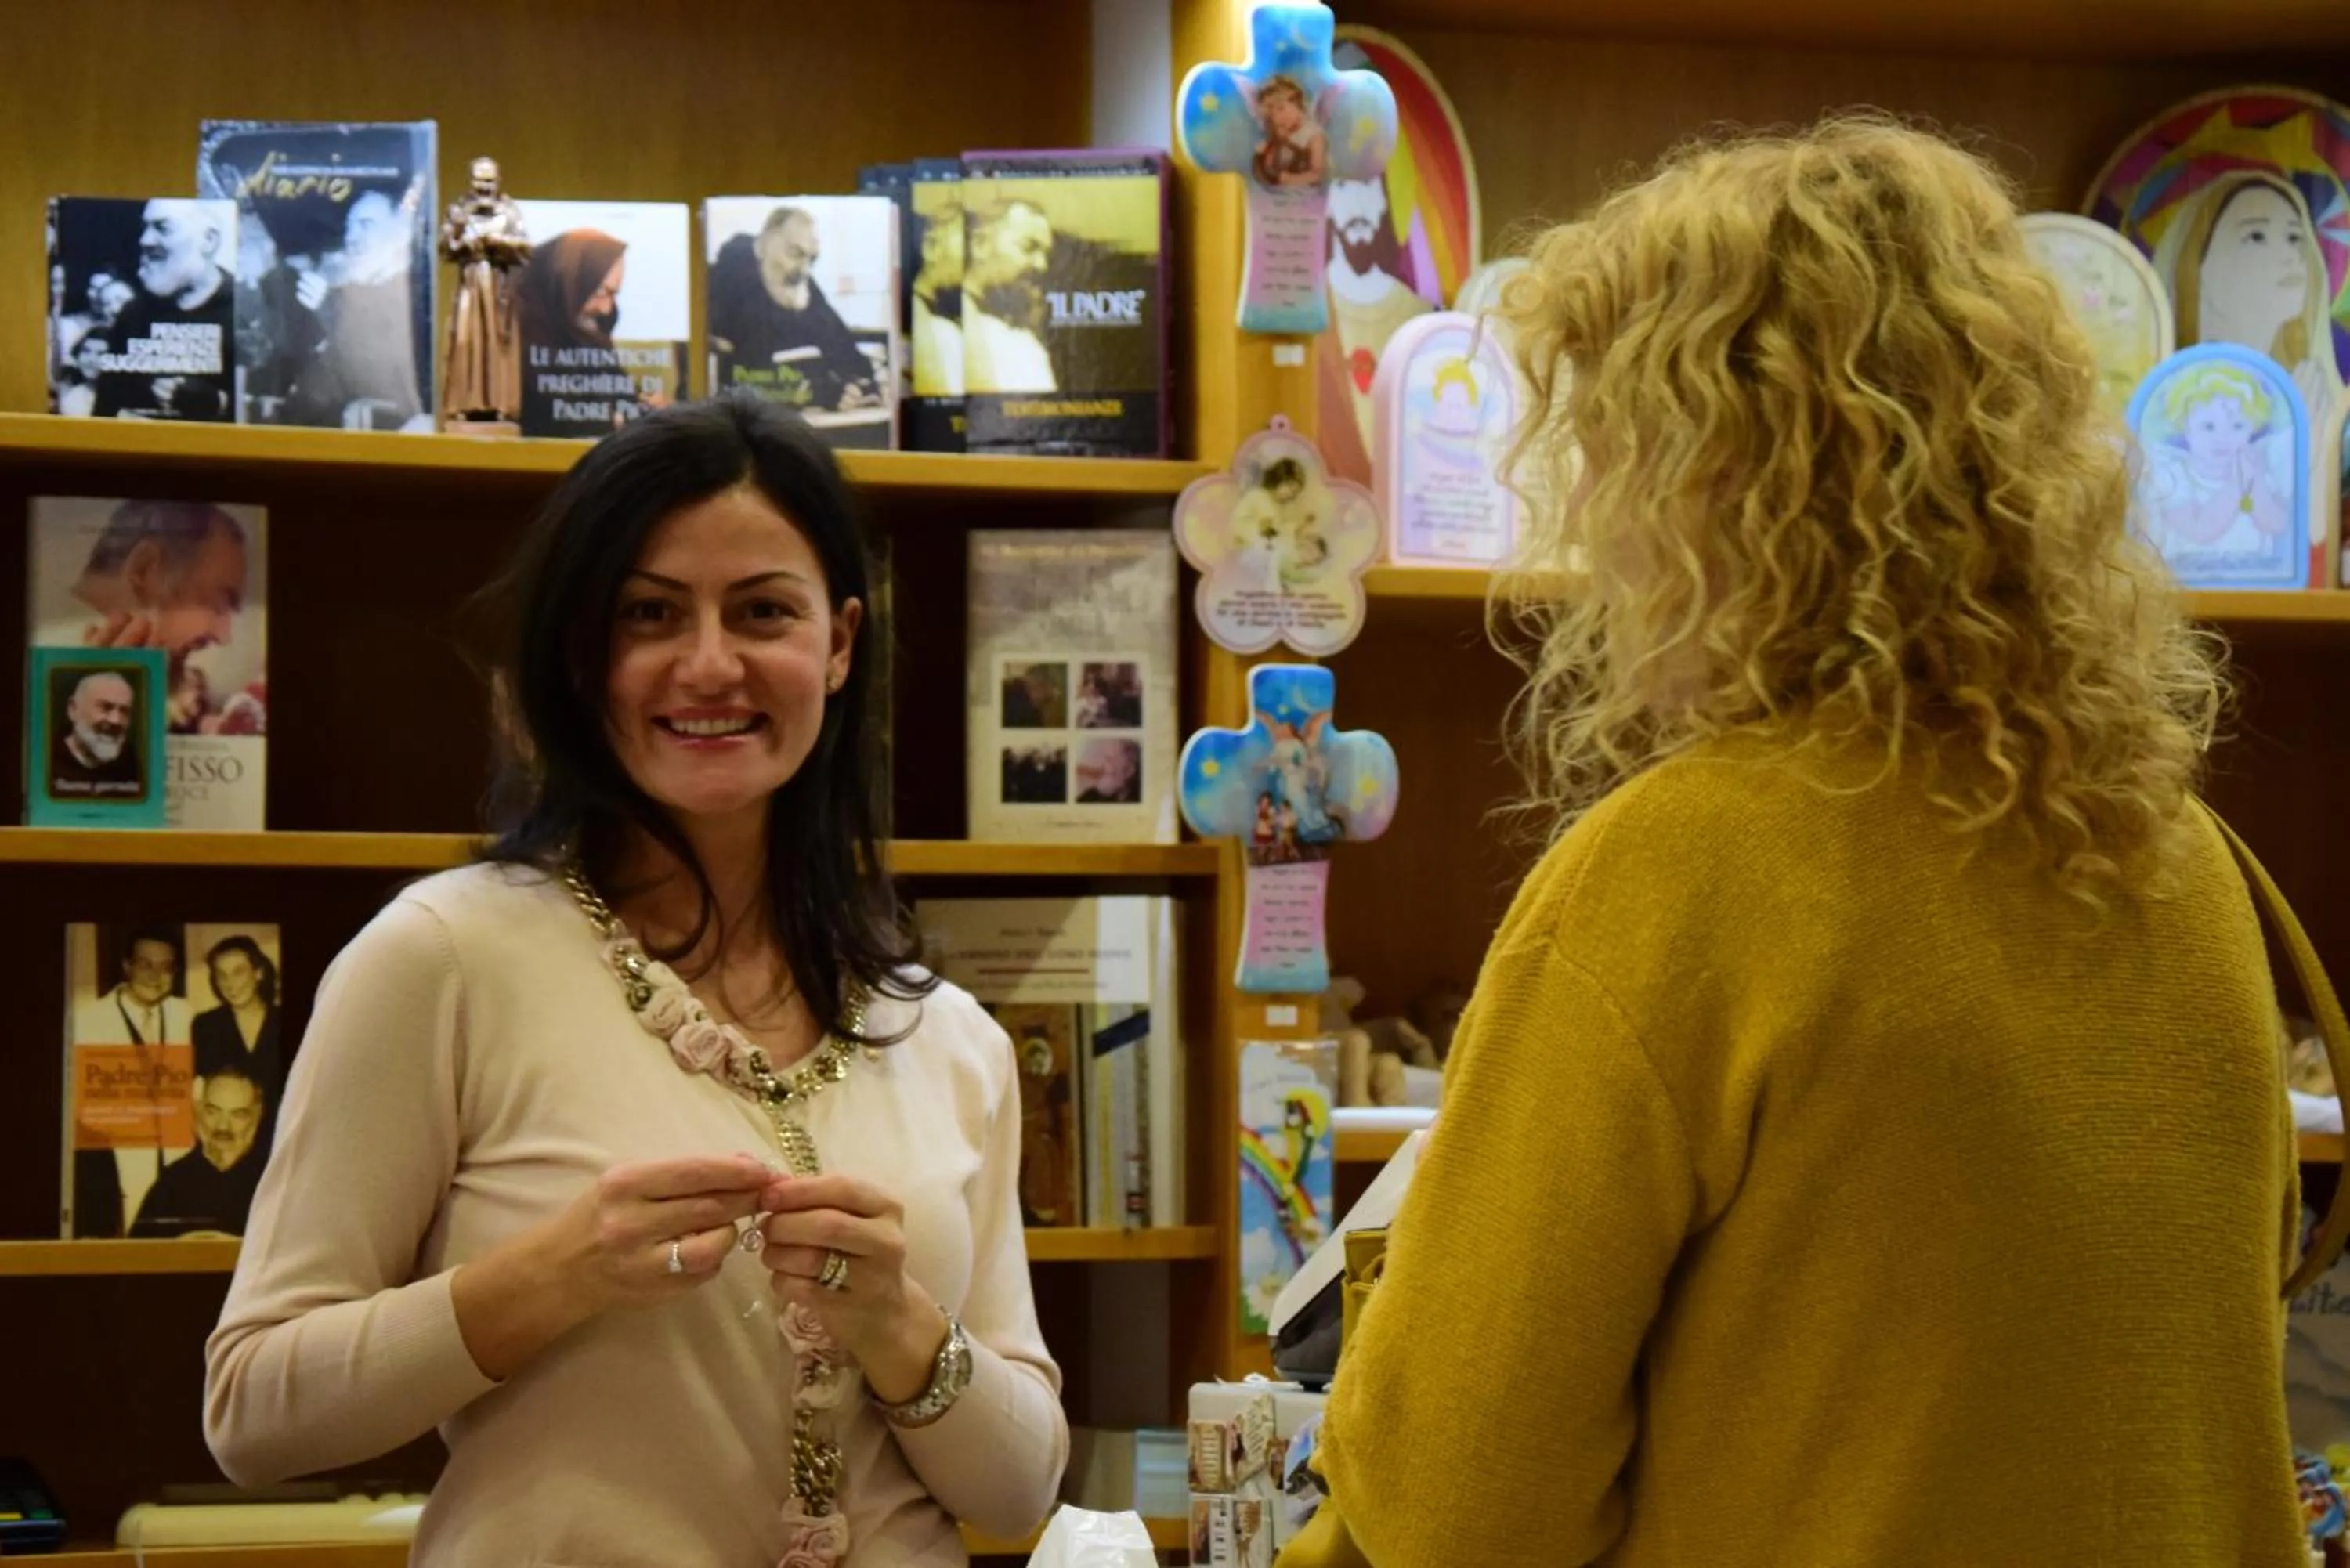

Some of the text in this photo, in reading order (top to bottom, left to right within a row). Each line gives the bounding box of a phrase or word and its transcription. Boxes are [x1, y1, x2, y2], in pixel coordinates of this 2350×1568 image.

[235, 150, 352, 202] diario
[85, 1062, 189, 1086] Padre Pio
